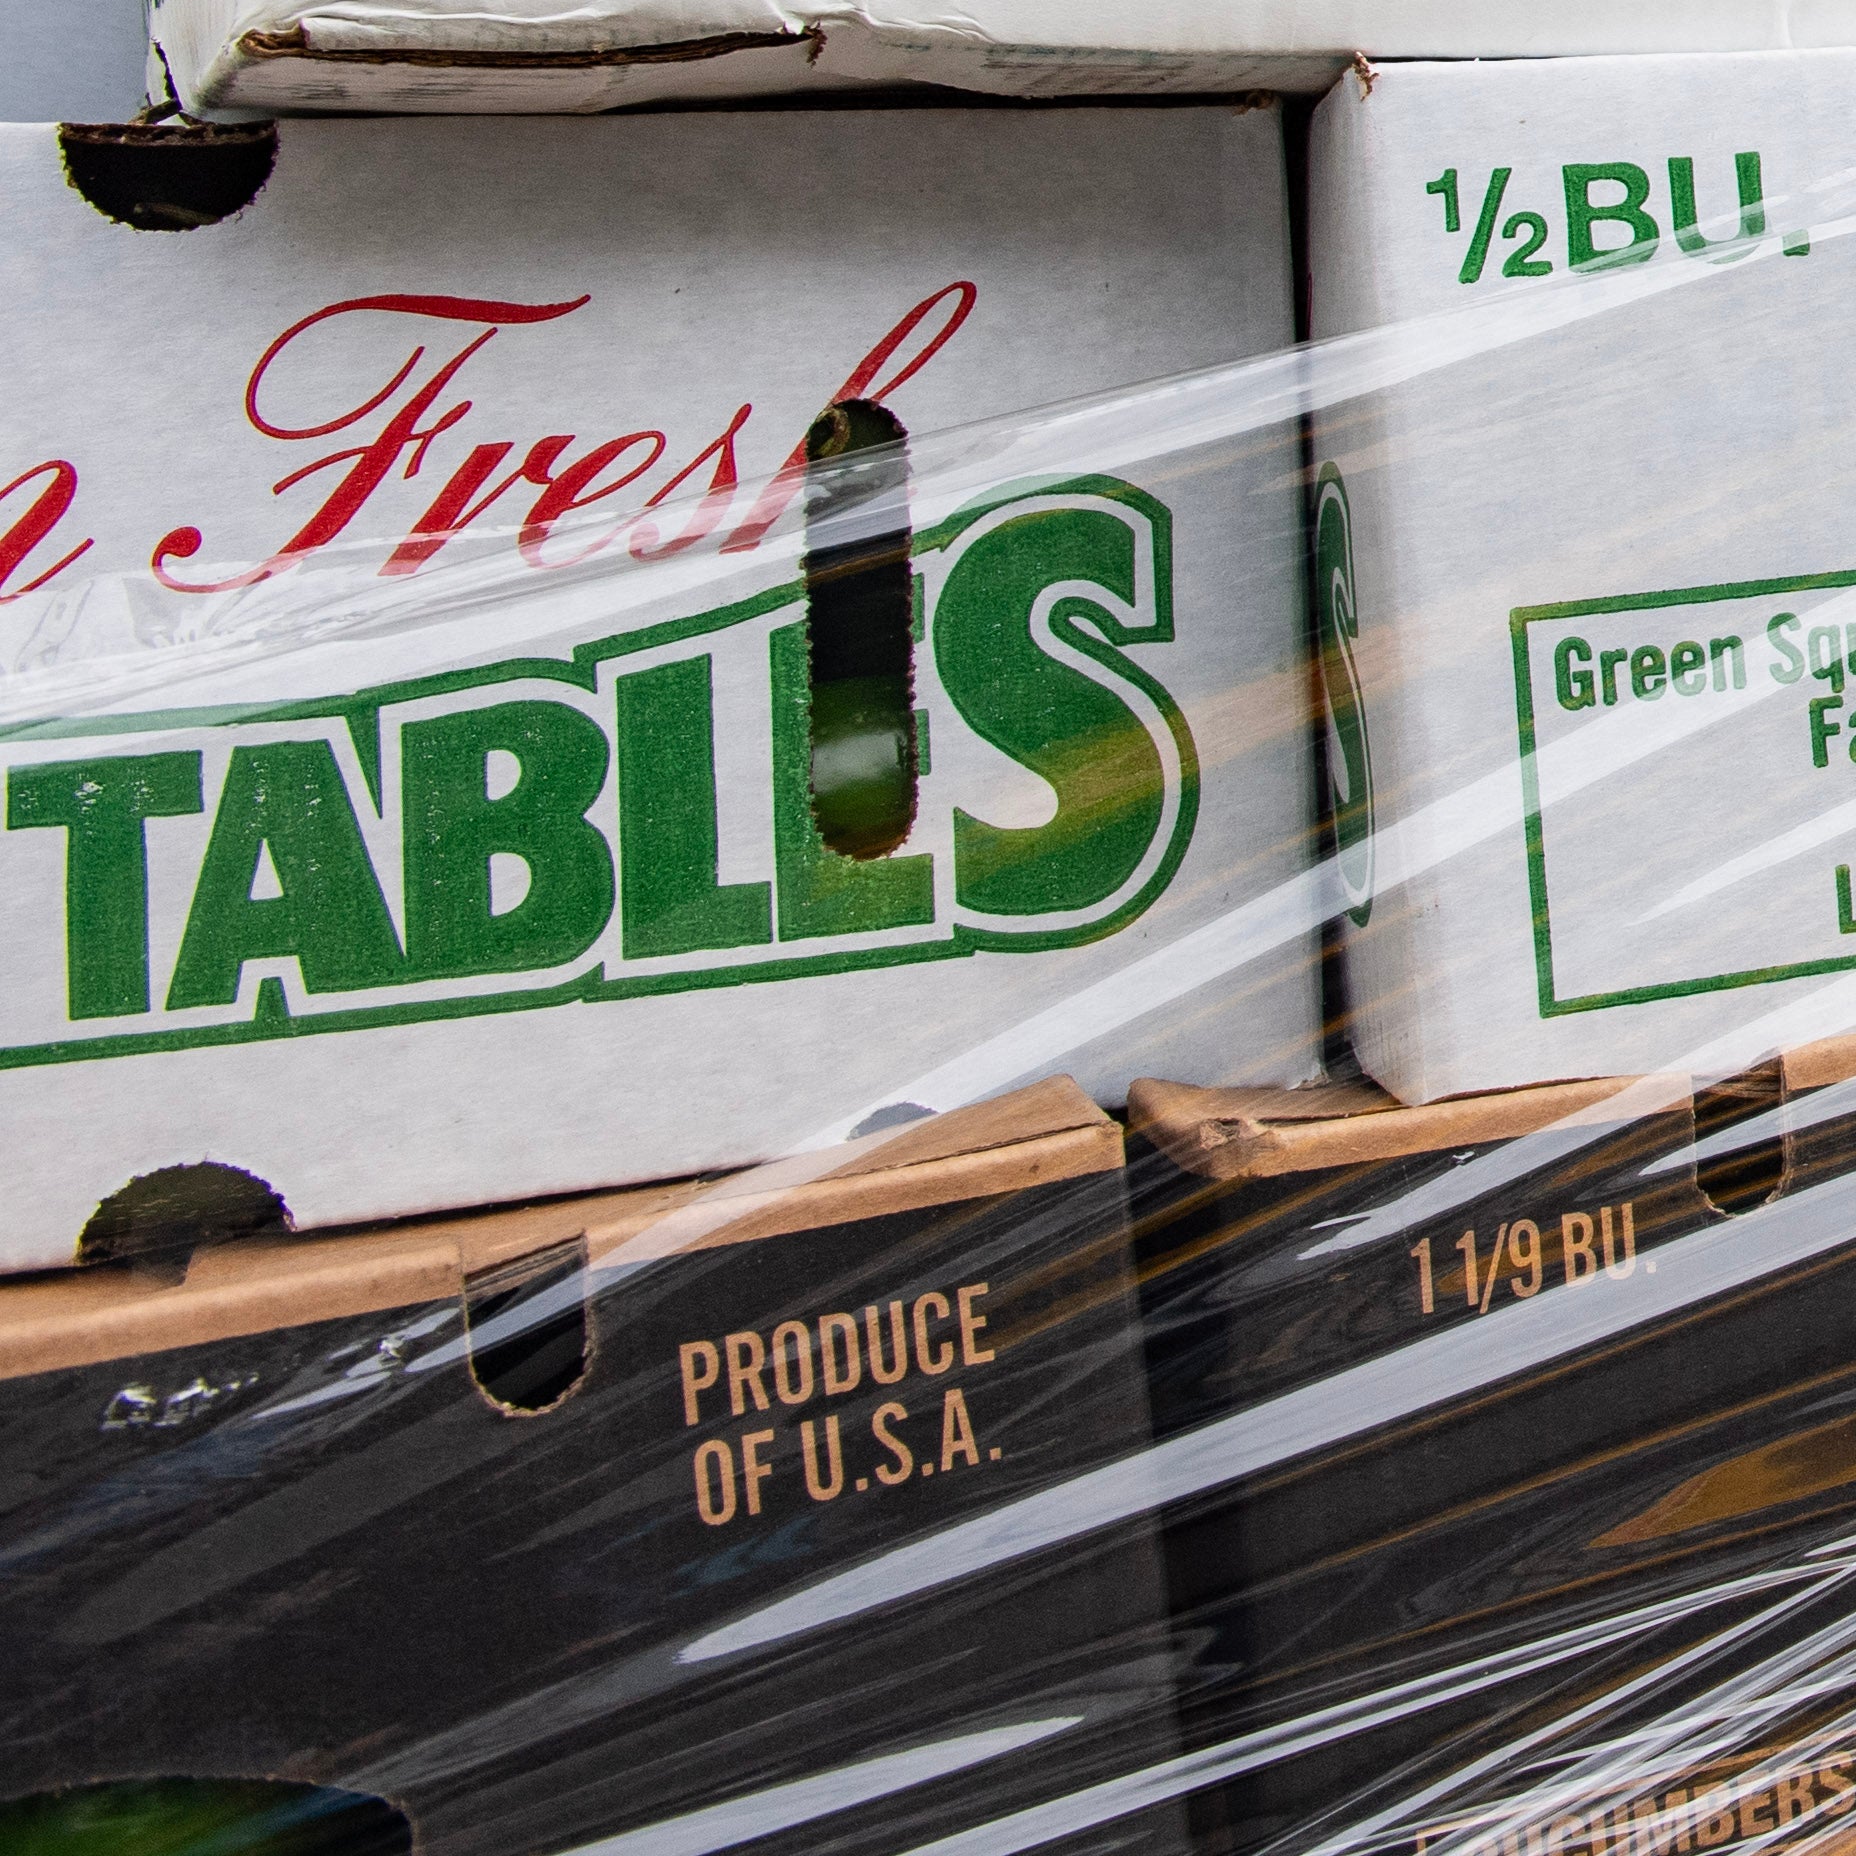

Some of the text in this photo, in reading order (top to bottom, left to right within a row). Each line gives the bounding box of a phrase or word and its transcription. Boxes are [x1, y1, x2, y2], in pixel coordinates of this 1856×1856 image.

[152, 281, 978, 594] Fresh
[1555, 624, 1750, 712] Green
[1410, 1204, 1657, 1314] 1 1/9 BU.
[680, 1282, 996, 1425] PRODUCE
[694, 1389, 1003, 1526] OF U.S.A.
